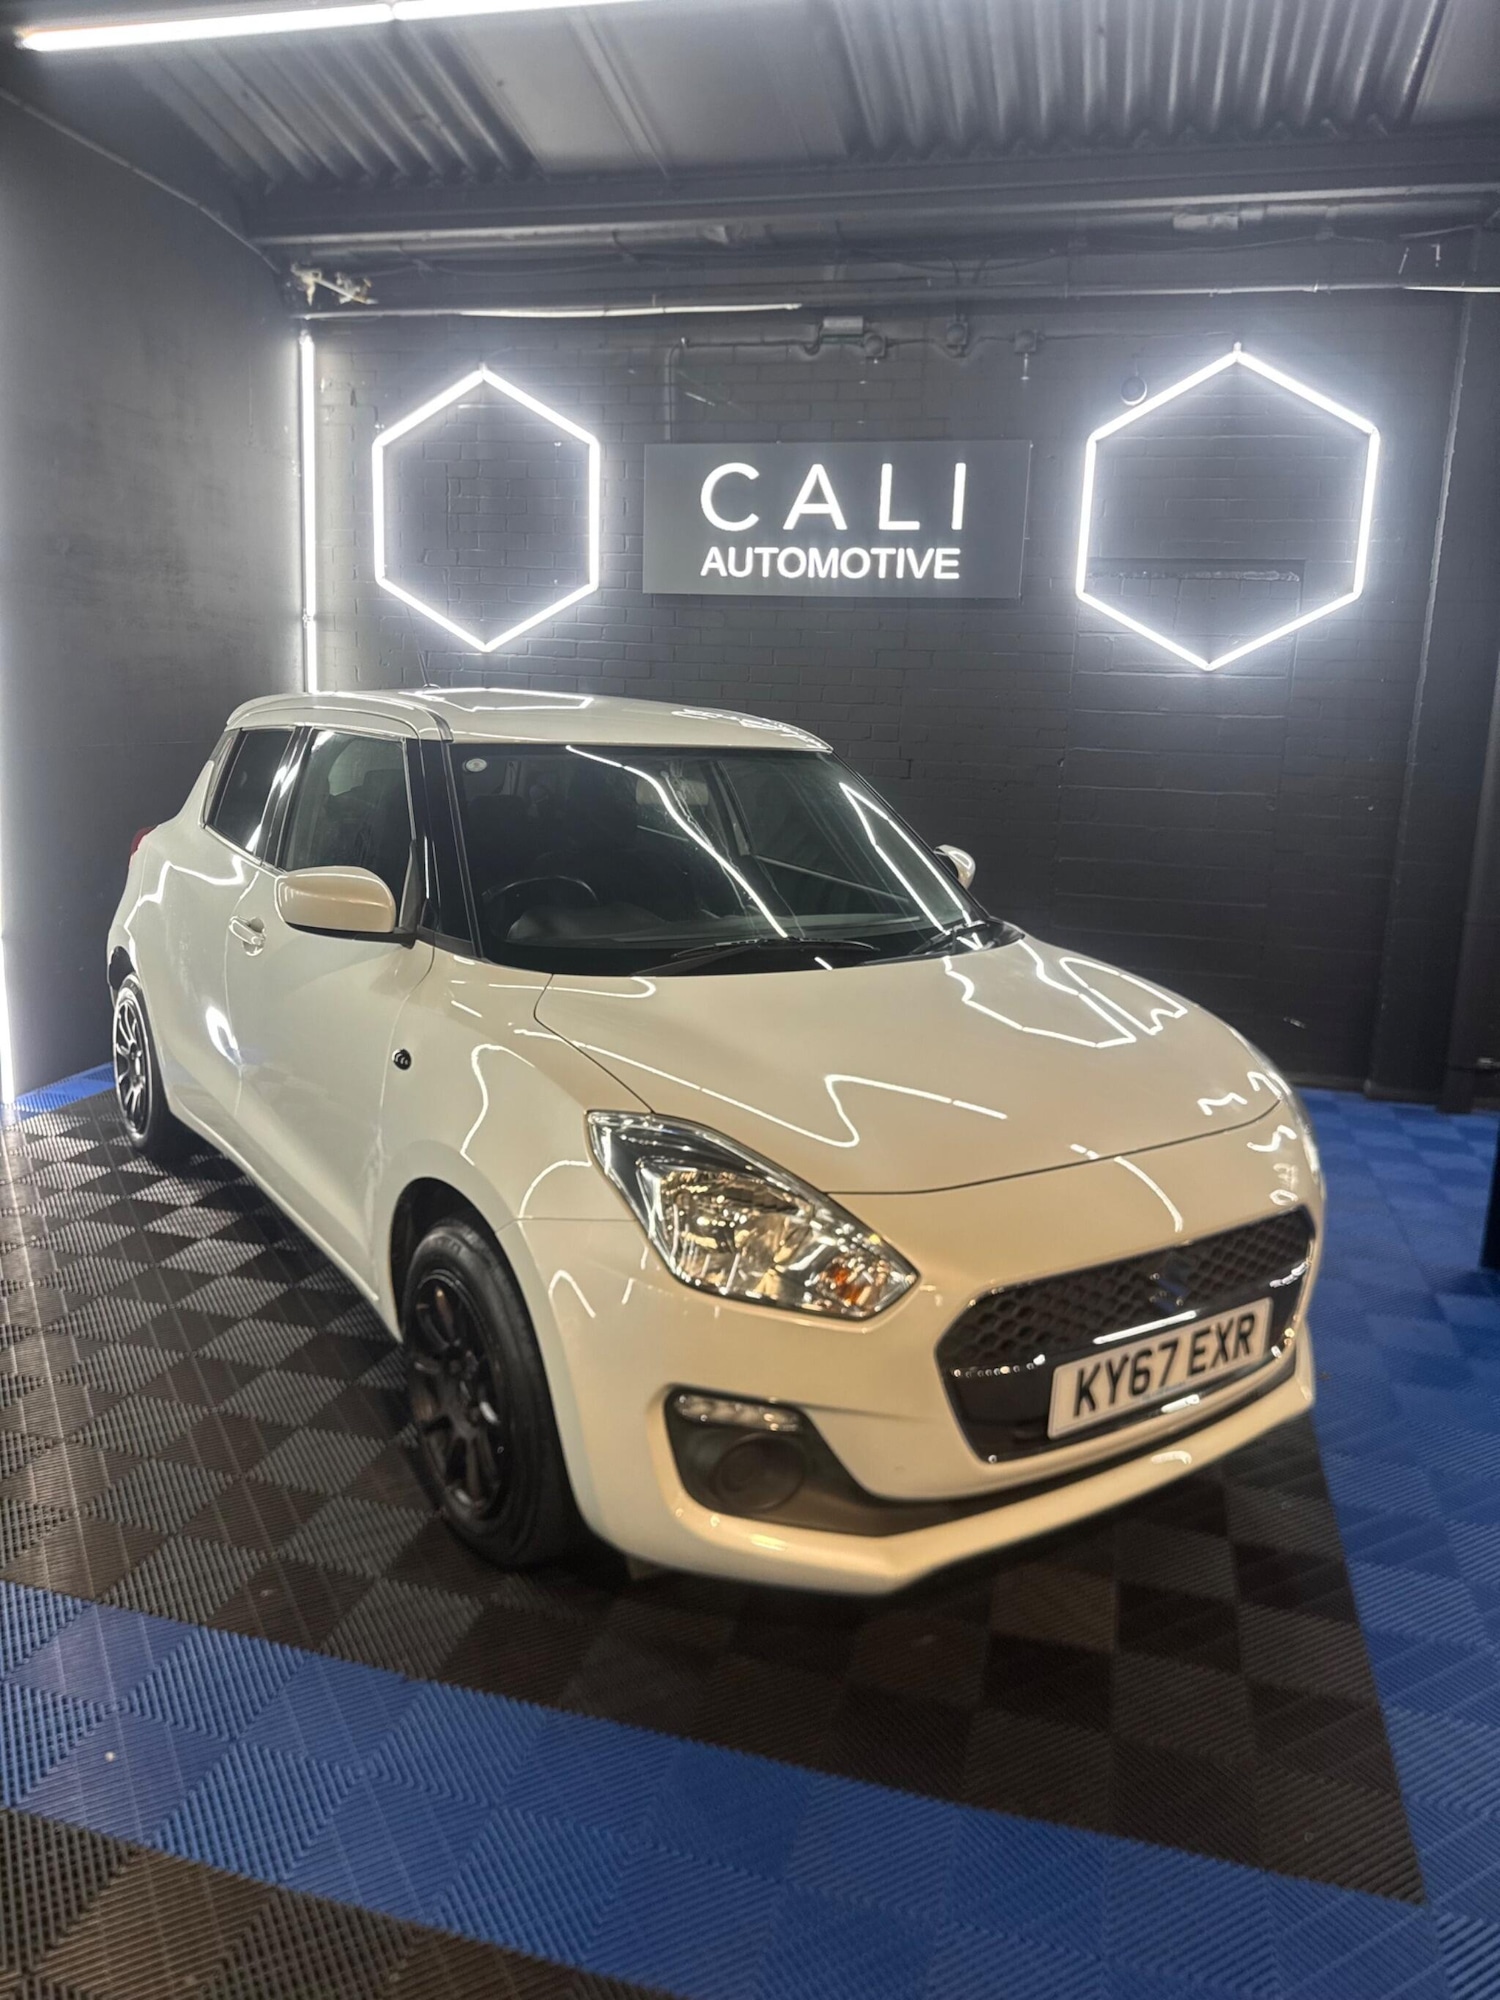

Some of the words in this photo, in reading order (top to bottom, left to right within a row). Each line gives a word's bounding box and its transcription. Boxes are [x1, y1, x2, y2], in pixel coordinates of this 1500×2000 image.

[700, 462, 967, 531] CALI
[700, 546, 961, 579] AUTOMOTIVE
[1073, 1339, 1180, 1417] KY67
[1187, 1312, 1256, 1377] EXR
